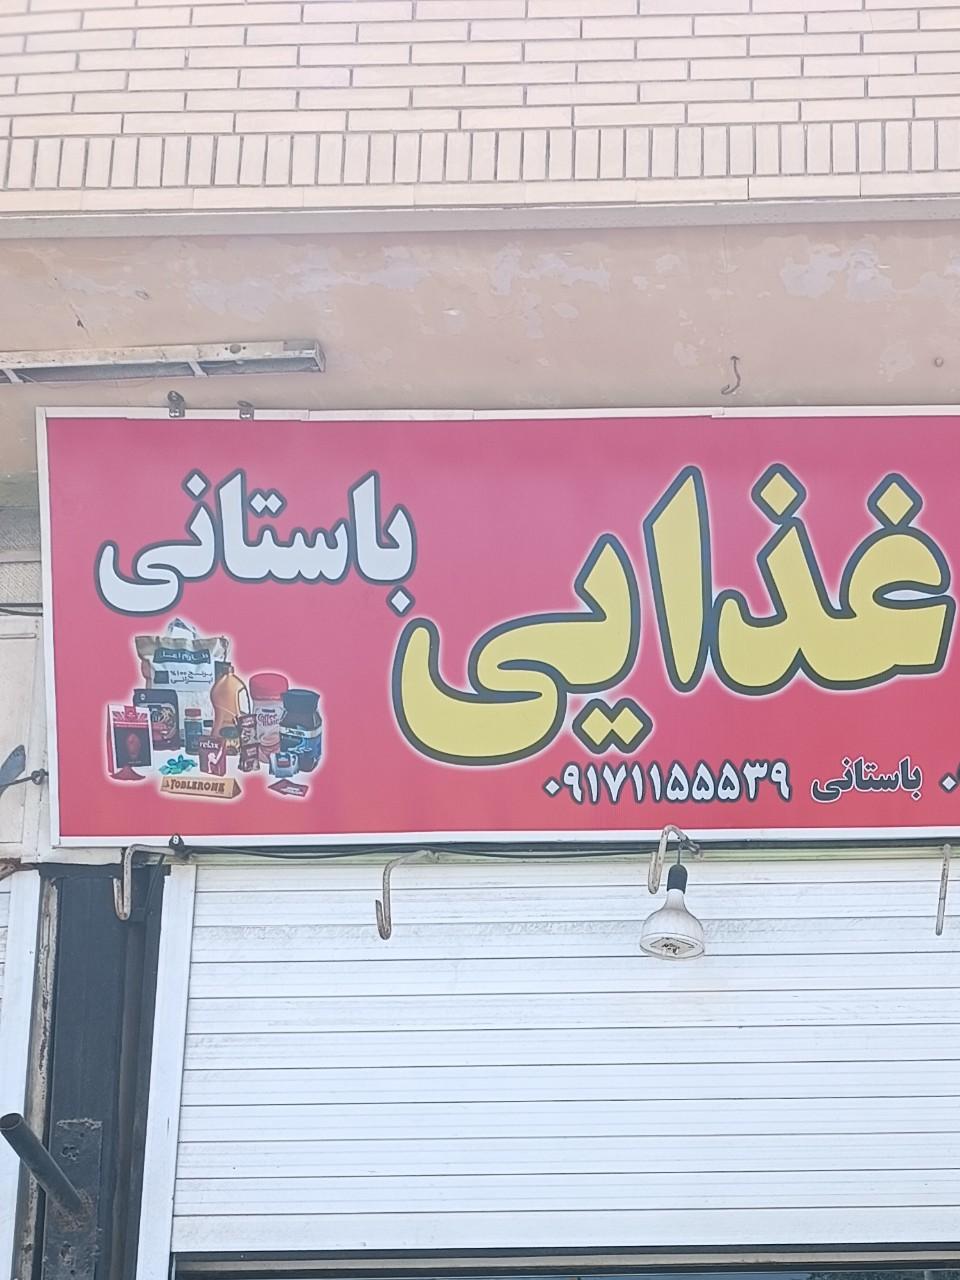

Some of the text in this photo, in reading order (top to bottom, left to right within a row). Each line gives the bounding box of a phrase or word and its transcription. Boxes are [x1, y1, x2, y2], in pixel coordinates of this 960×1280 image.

[95, 469, 418, 616] باستانی
[393, 463, 955, 766] غذایی
[170, 778, 225, 793] TOBLERONE
[543, 758, 792, 803] ۰۹۱۷۱۱۵۵۵۳۹
[810, 756, 923, 804] باستانی
